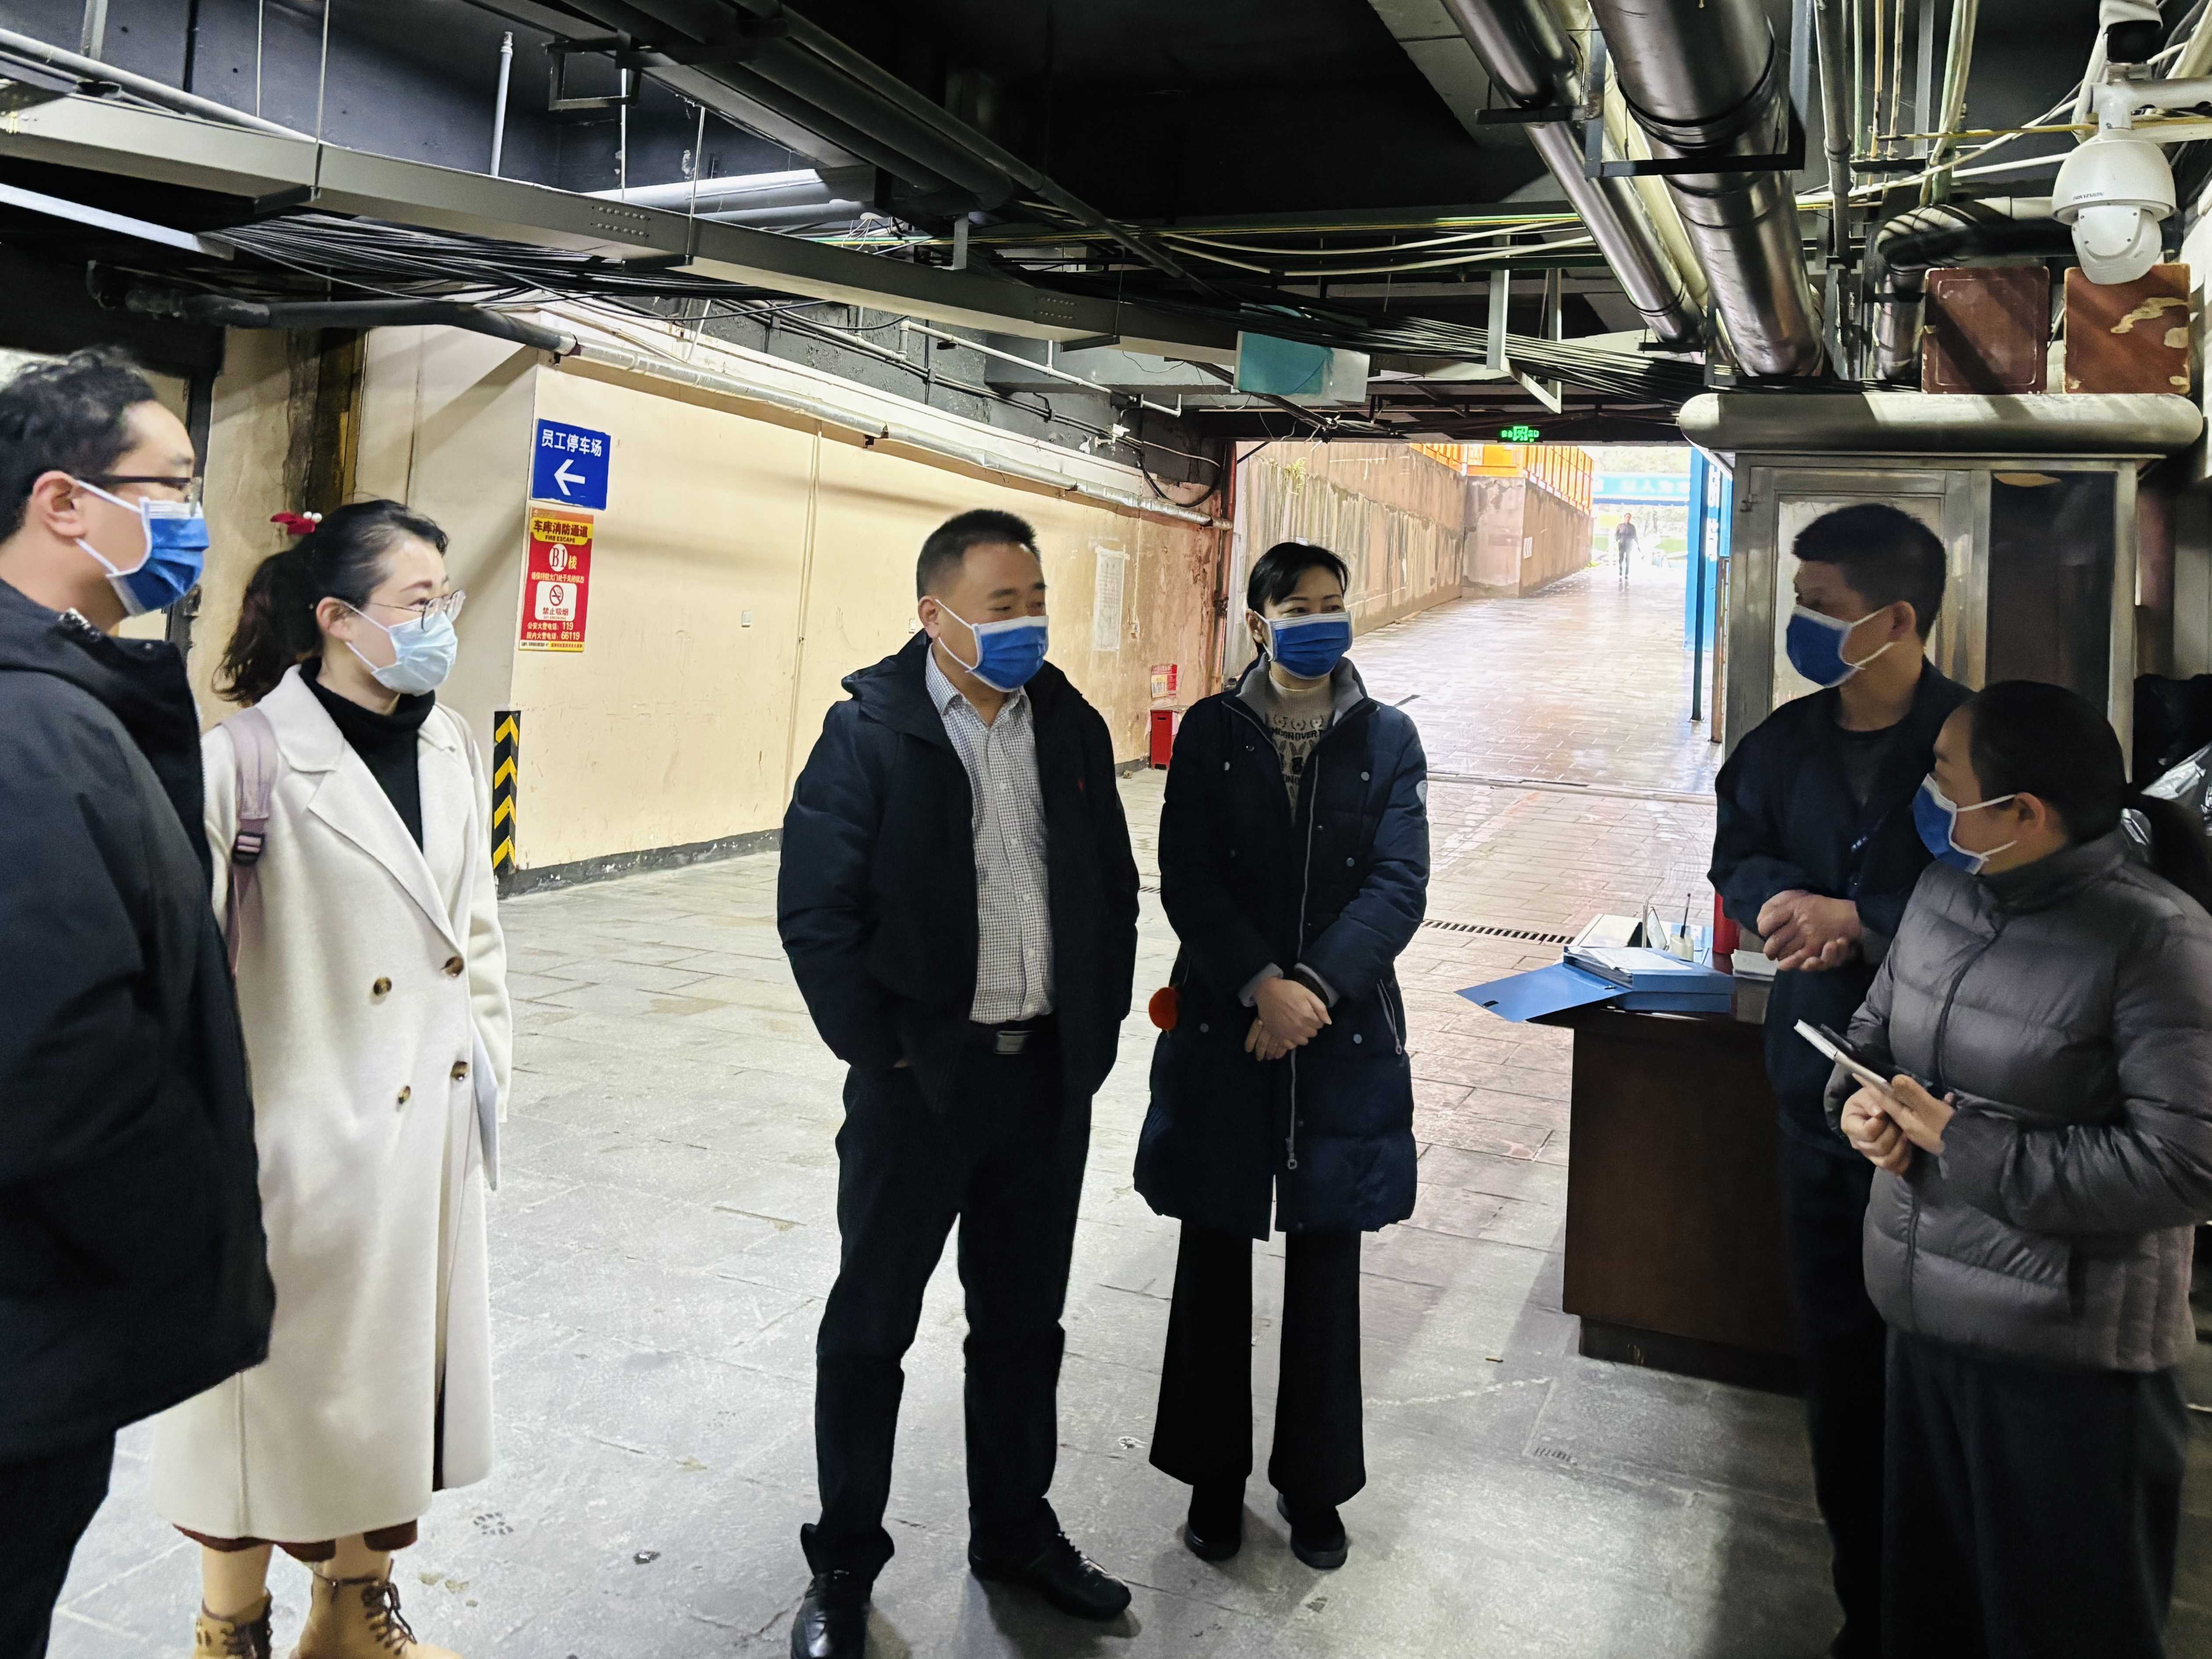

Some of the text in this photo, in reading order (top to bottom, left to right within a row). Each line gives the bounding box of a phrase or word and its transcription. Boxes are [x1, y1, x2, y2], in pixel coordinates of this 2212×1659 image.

[541, 428, 602, 457] 员工停车场
[533, 520, 588, 538] 车库消防通道
[542, 607, 569, 616] 禁止吸烟
